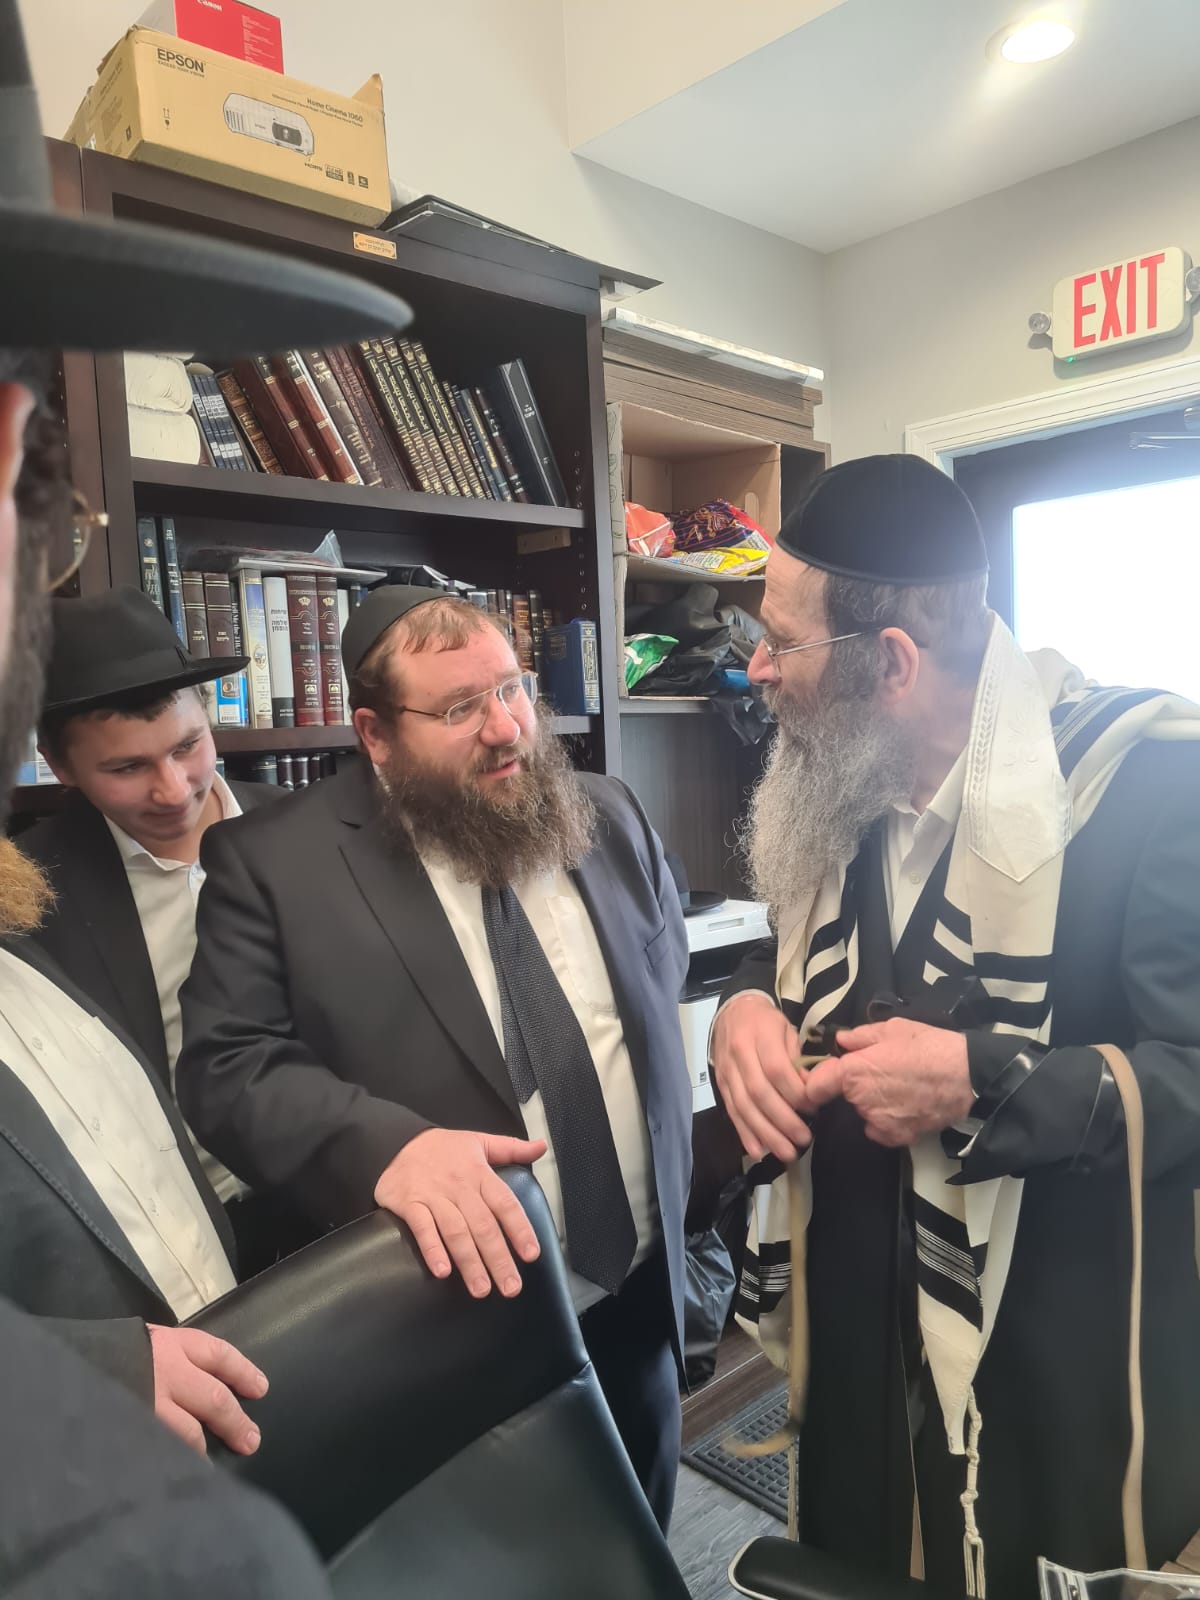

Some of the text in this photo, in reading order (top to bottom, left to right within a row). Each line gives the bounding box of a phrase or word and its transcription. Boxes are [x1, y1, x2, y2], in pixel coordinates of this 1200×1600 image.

[157, 48, 205, 73] EPSON
[307, 98, 325, 110] Home
[325, 103, 347, 117] Cinema
[1074, 253, 1165, 348] EXIT
